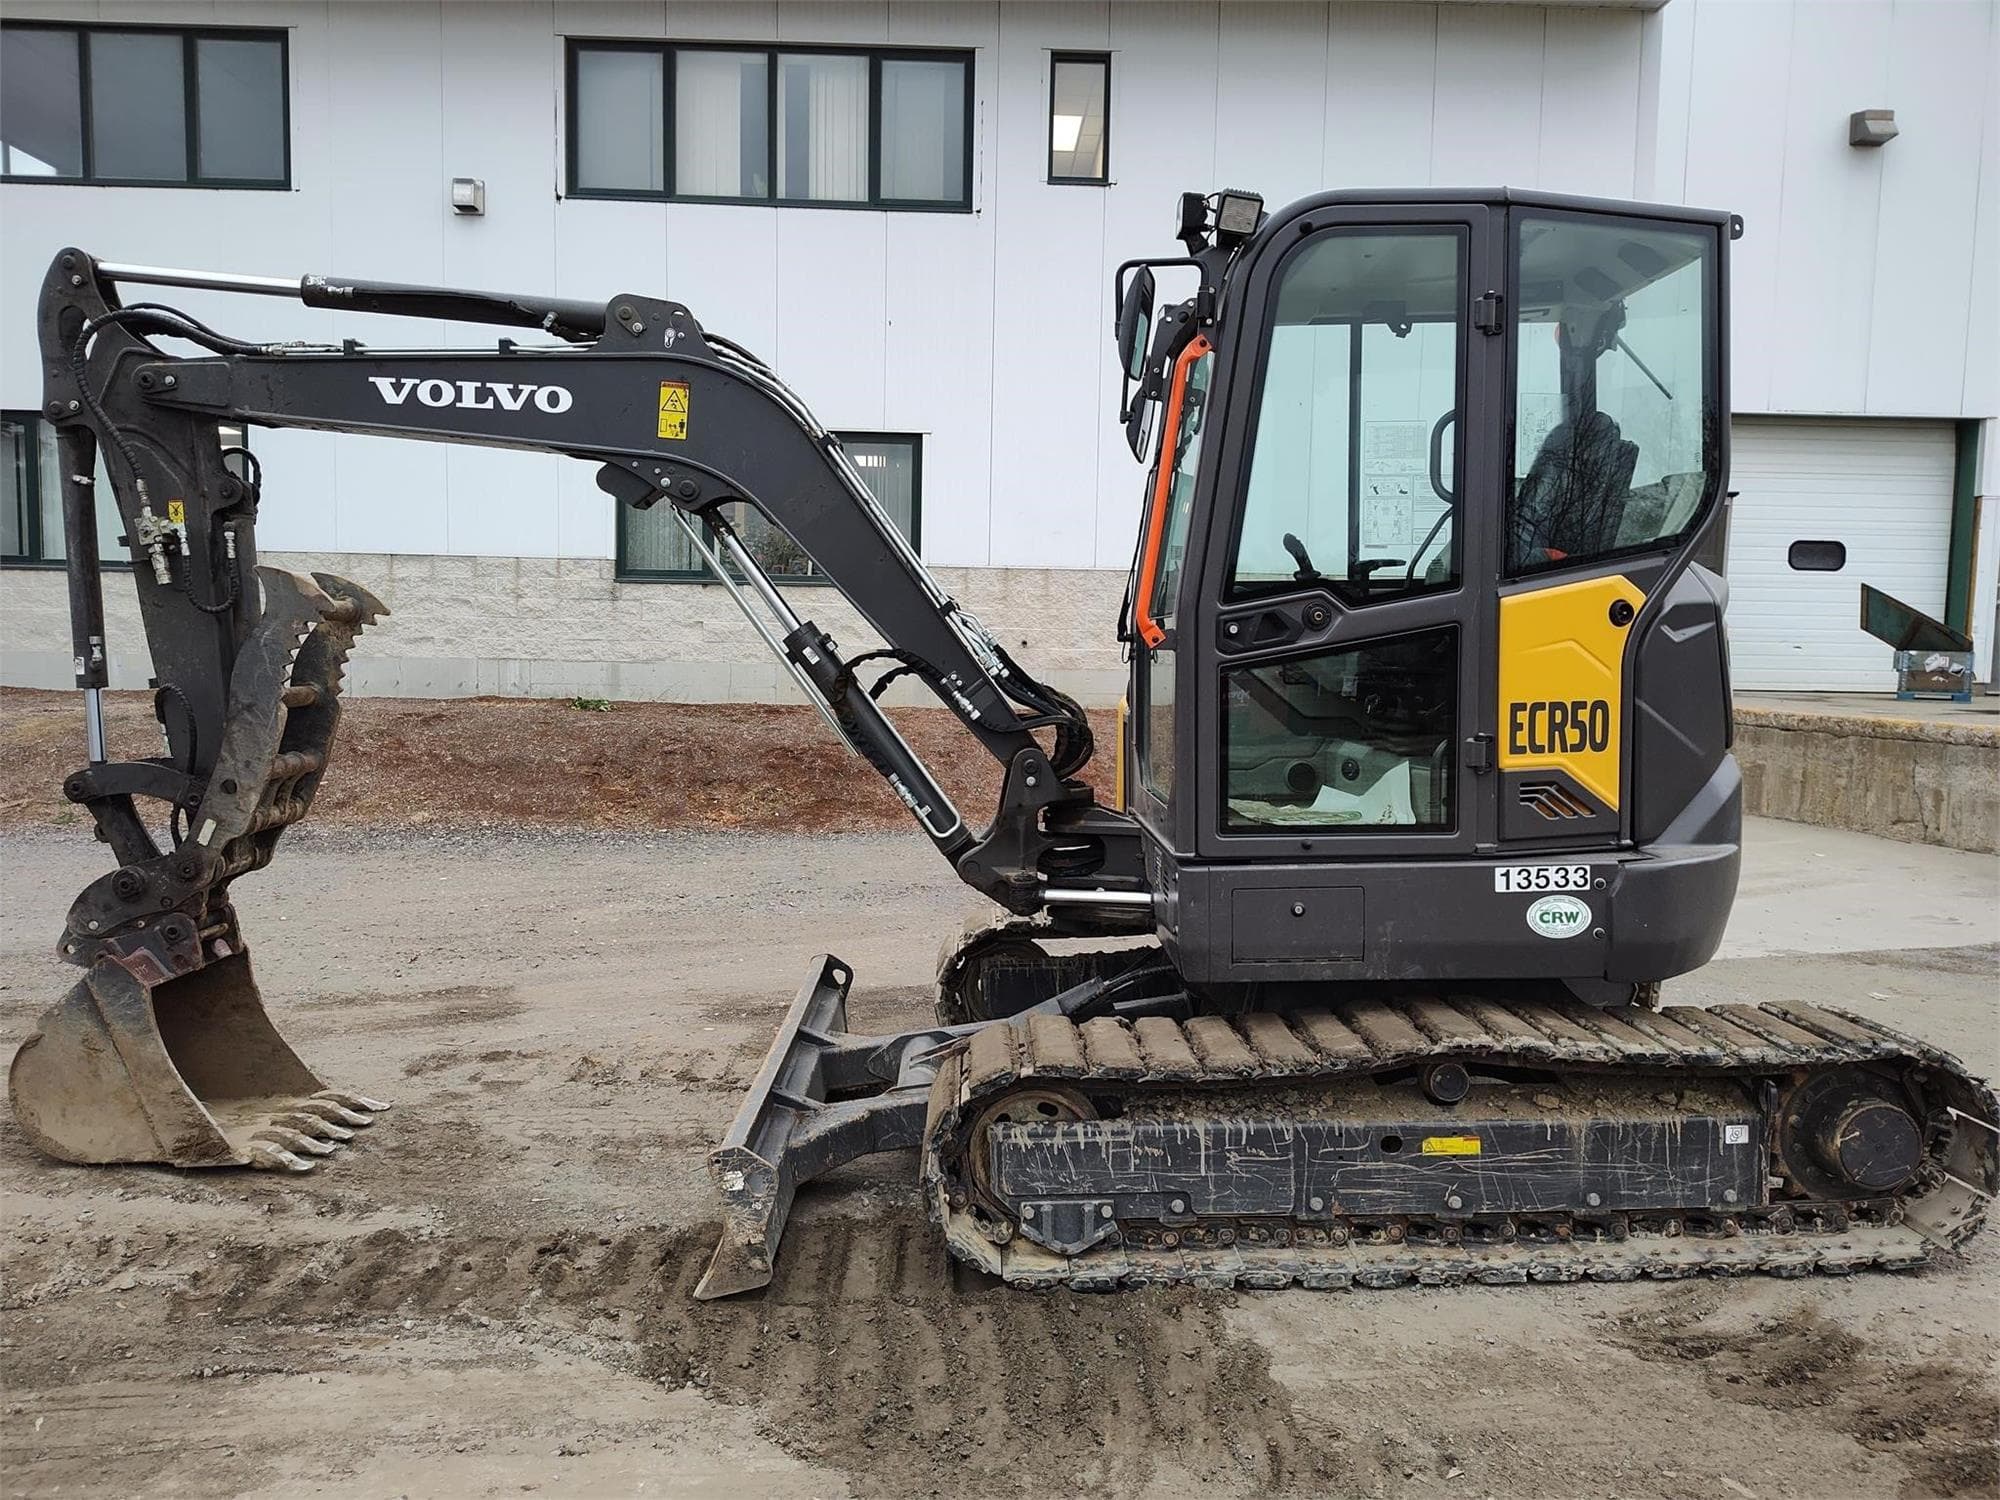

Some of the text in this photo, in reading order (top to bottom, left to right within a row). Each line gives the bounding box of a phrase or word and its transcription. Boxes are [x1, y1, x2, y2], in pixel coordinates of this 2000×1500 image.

[368, 376, 573, 414] VOLVO
[1509, 699, 1610, 755] ECR50
[1500, 867, 1589, 891] 13533
[1539, 911, 1580, 924] CRW
